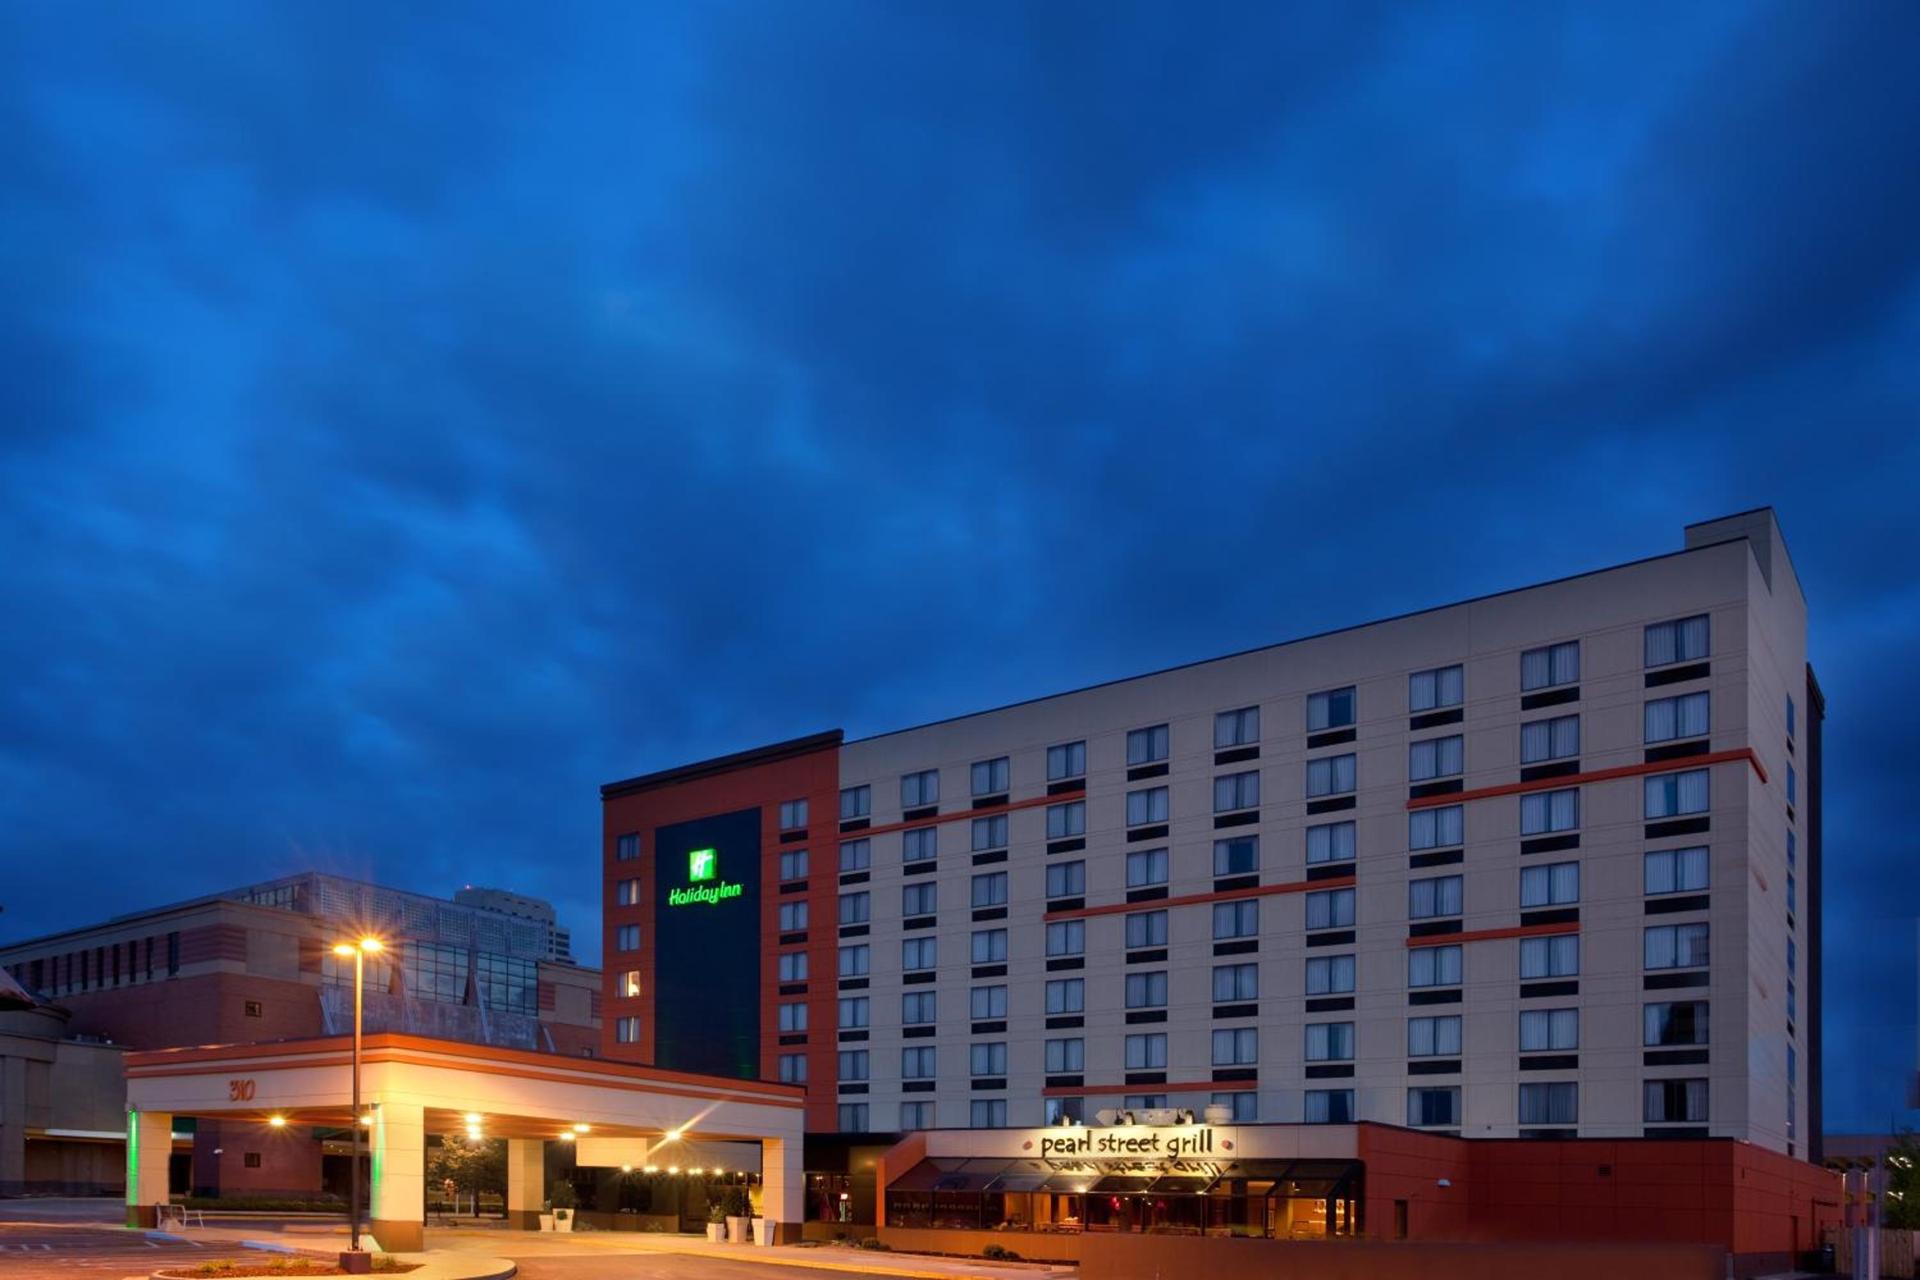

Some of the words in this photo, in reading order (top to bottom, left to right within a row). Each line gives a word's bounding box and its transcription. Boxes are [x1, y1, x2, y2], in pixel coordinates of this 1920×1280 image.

[669, 885, 719, 906] Holiday
[719, 881, 741, 898] Inn
[229, 1079, 256, 1102] 310
[1042, 1130, 1091, 1158] pearl
[1098, 1133, 1160, 1152] street
[1167, 1129, 1212, 1158] grill
